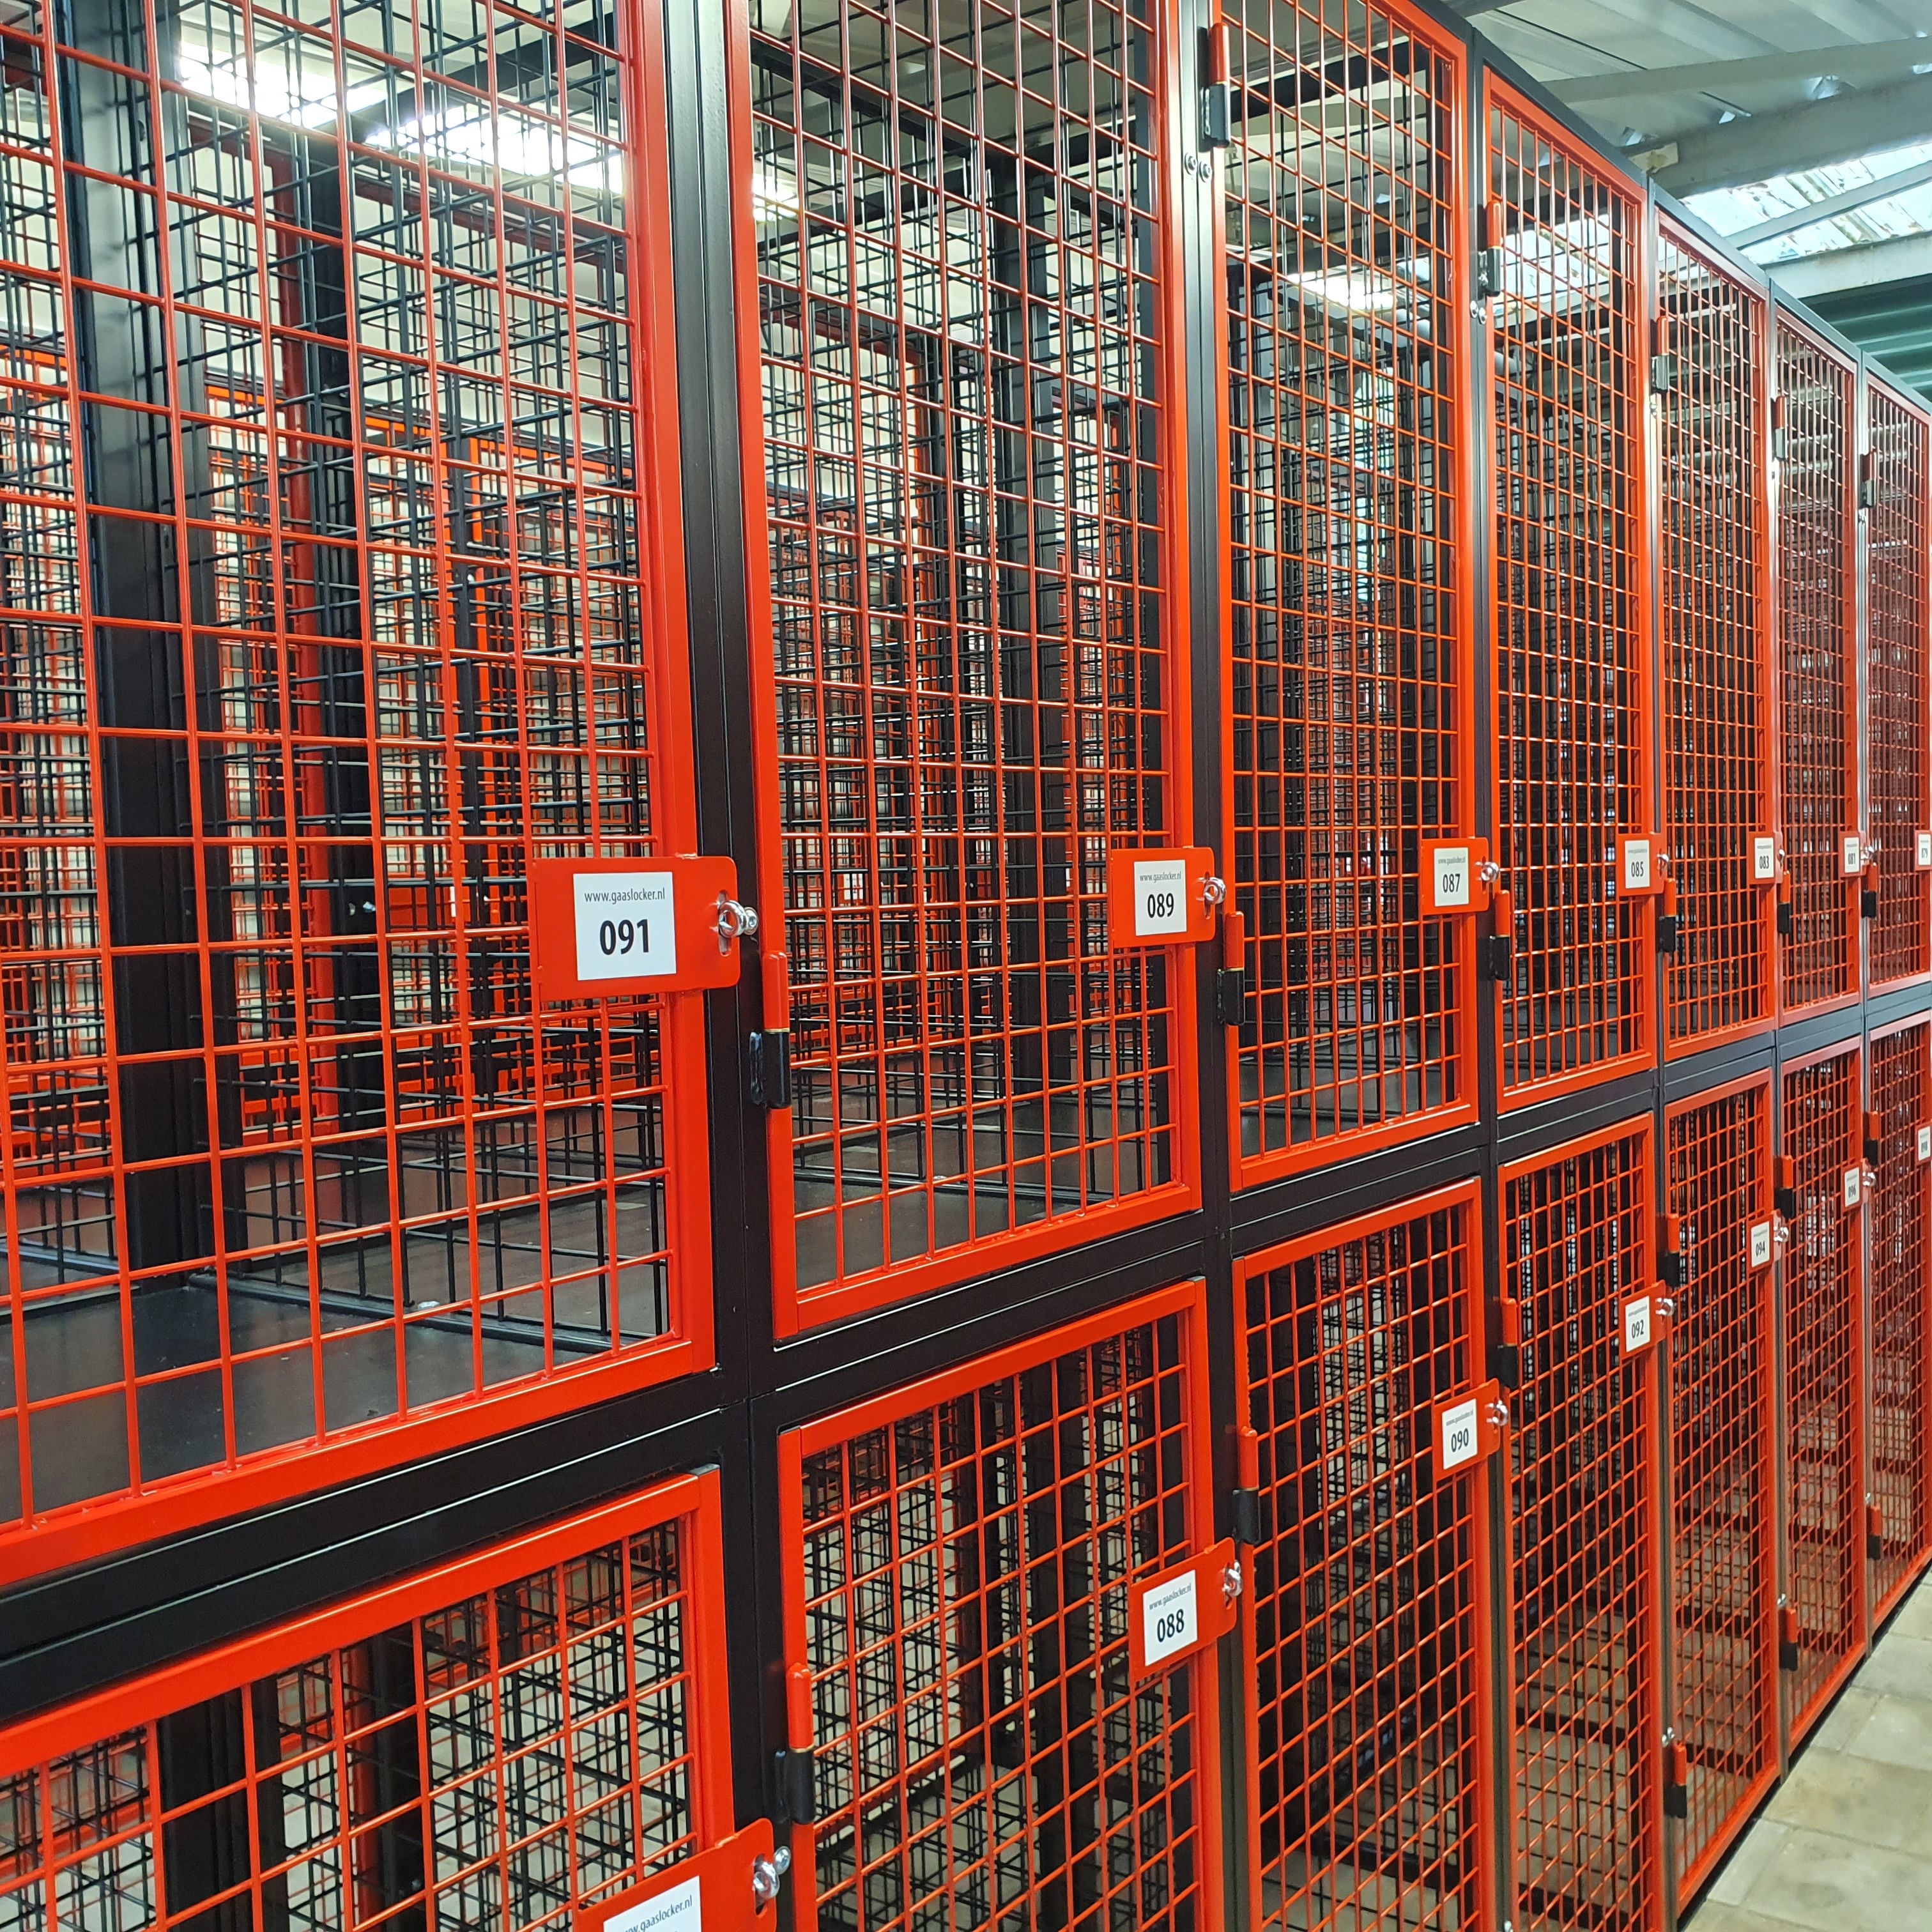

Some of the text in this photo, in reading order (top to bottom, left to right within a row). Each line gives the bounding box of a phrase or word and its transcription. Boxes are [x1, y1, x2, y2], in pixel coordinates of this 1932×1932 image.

[1631, 861, 1644, 877] 085
[1759, 855, 1769, 869] 083
[1140, 871, 1181, 883] www.gaaslocker.nl
[1443, 873, 1460, 893] 087
[584, 887, 666, 904] www.gaaslocker.nl
[1147, 893, 1174, 918] 089
[599, 919, 649, 955] 091
[1756, 1240, 1765, 1257] 094
[1631, 1319, 1644, 1339] 092
[1451, 1428, 1469, 1452] 090
[1157, 1609, 1184, 1643] 088
